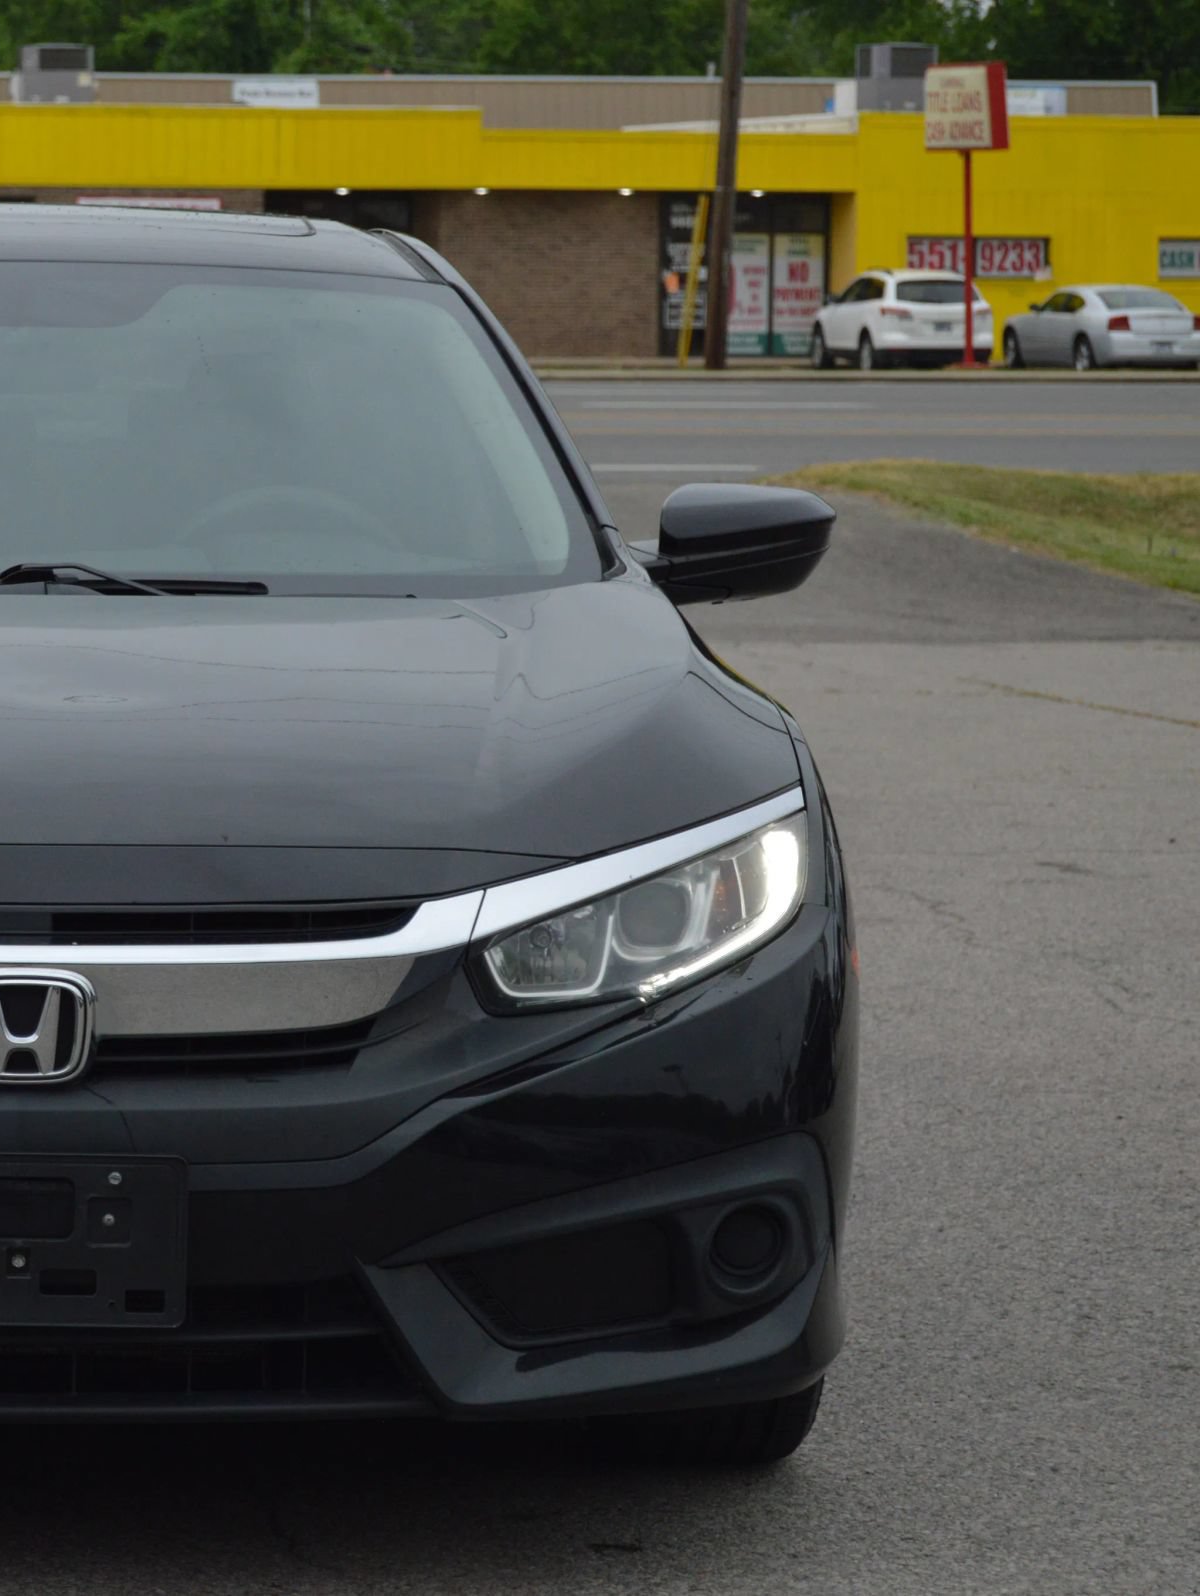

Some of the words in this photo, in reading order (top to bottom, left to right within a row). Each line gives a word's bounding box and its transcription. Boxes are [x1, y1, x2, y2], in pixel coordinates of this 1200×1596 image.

[980, 240, 1041, 272] 9233
[1160, 248, 1195, 270] CASH
[787, 260, 810, 283] NO
